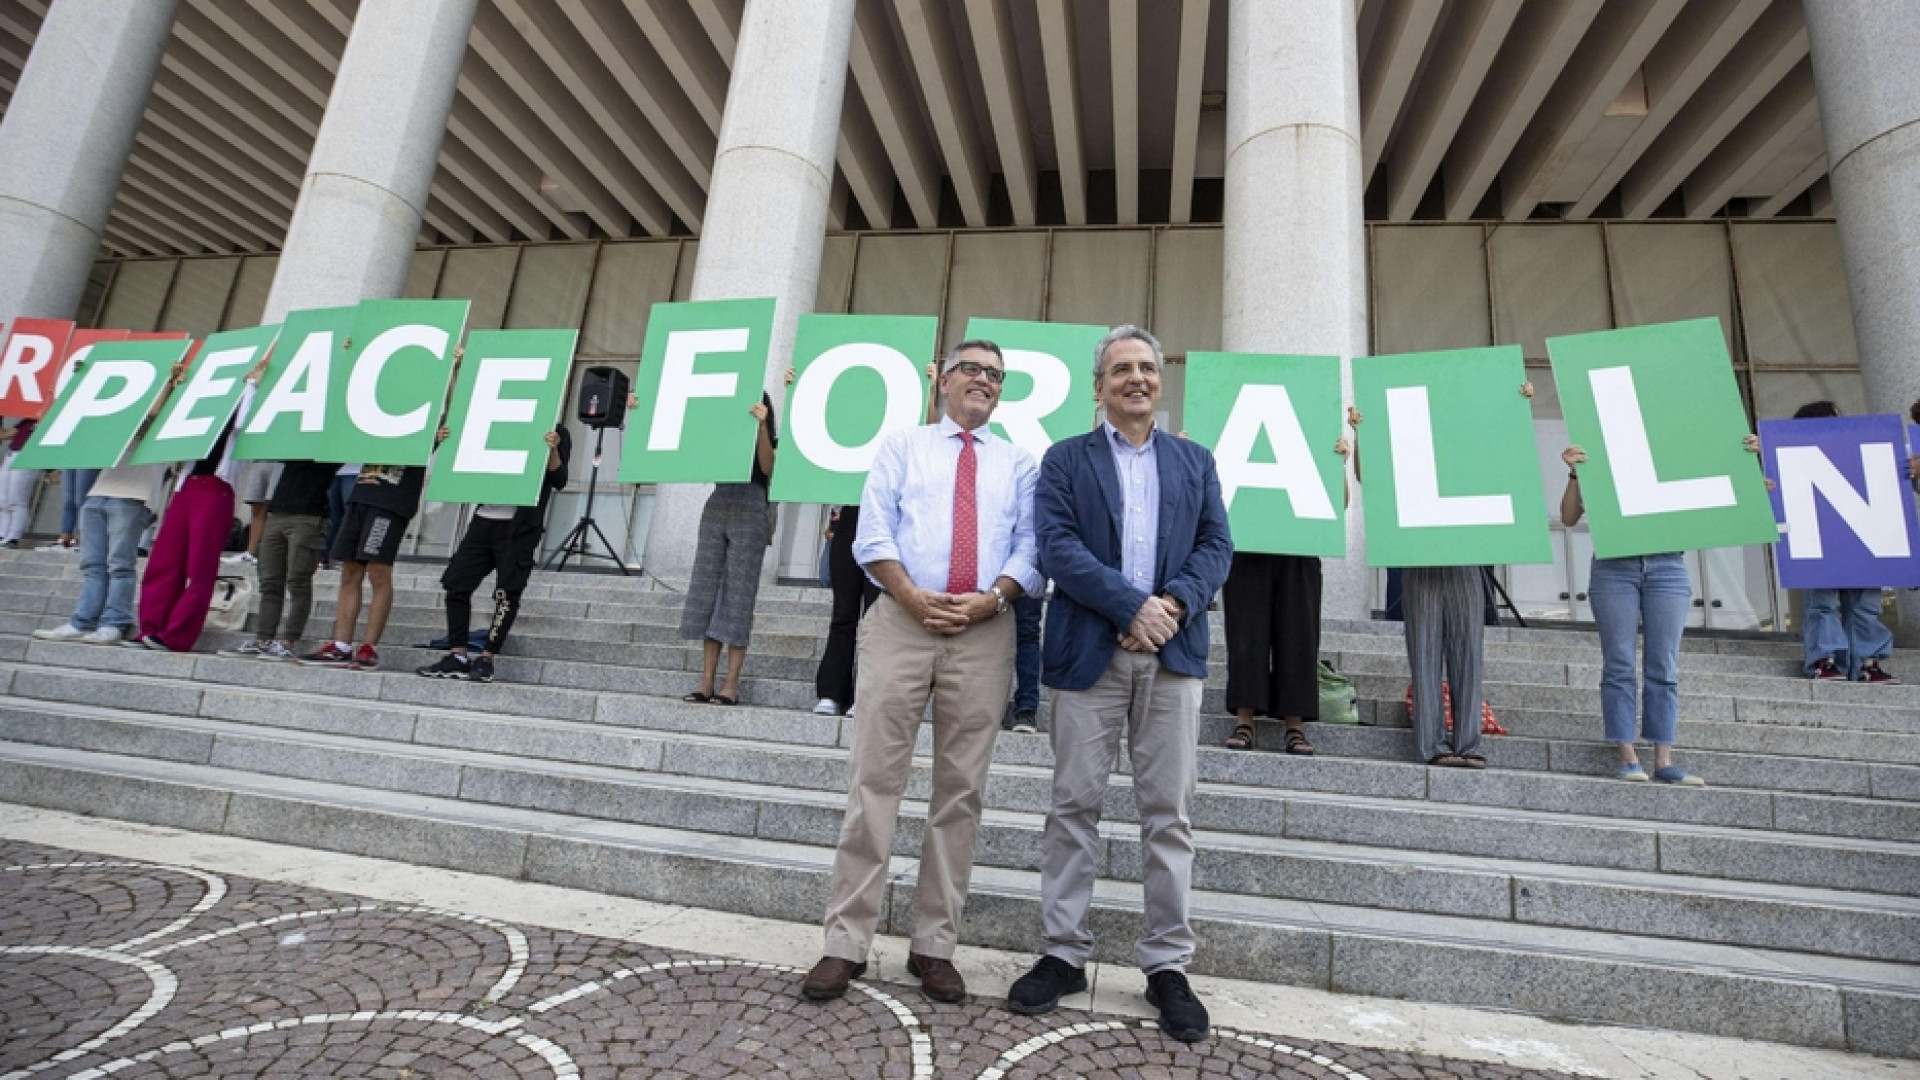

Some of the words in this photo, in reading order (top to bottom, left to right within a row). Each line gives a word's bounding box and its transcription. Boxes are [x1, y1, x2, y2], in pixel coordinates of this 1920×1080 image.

[38, 323, 551, 475] PEACE
[646, 327, 1071, 473] FOR
[1214, 365, 1738, 527] ALL
